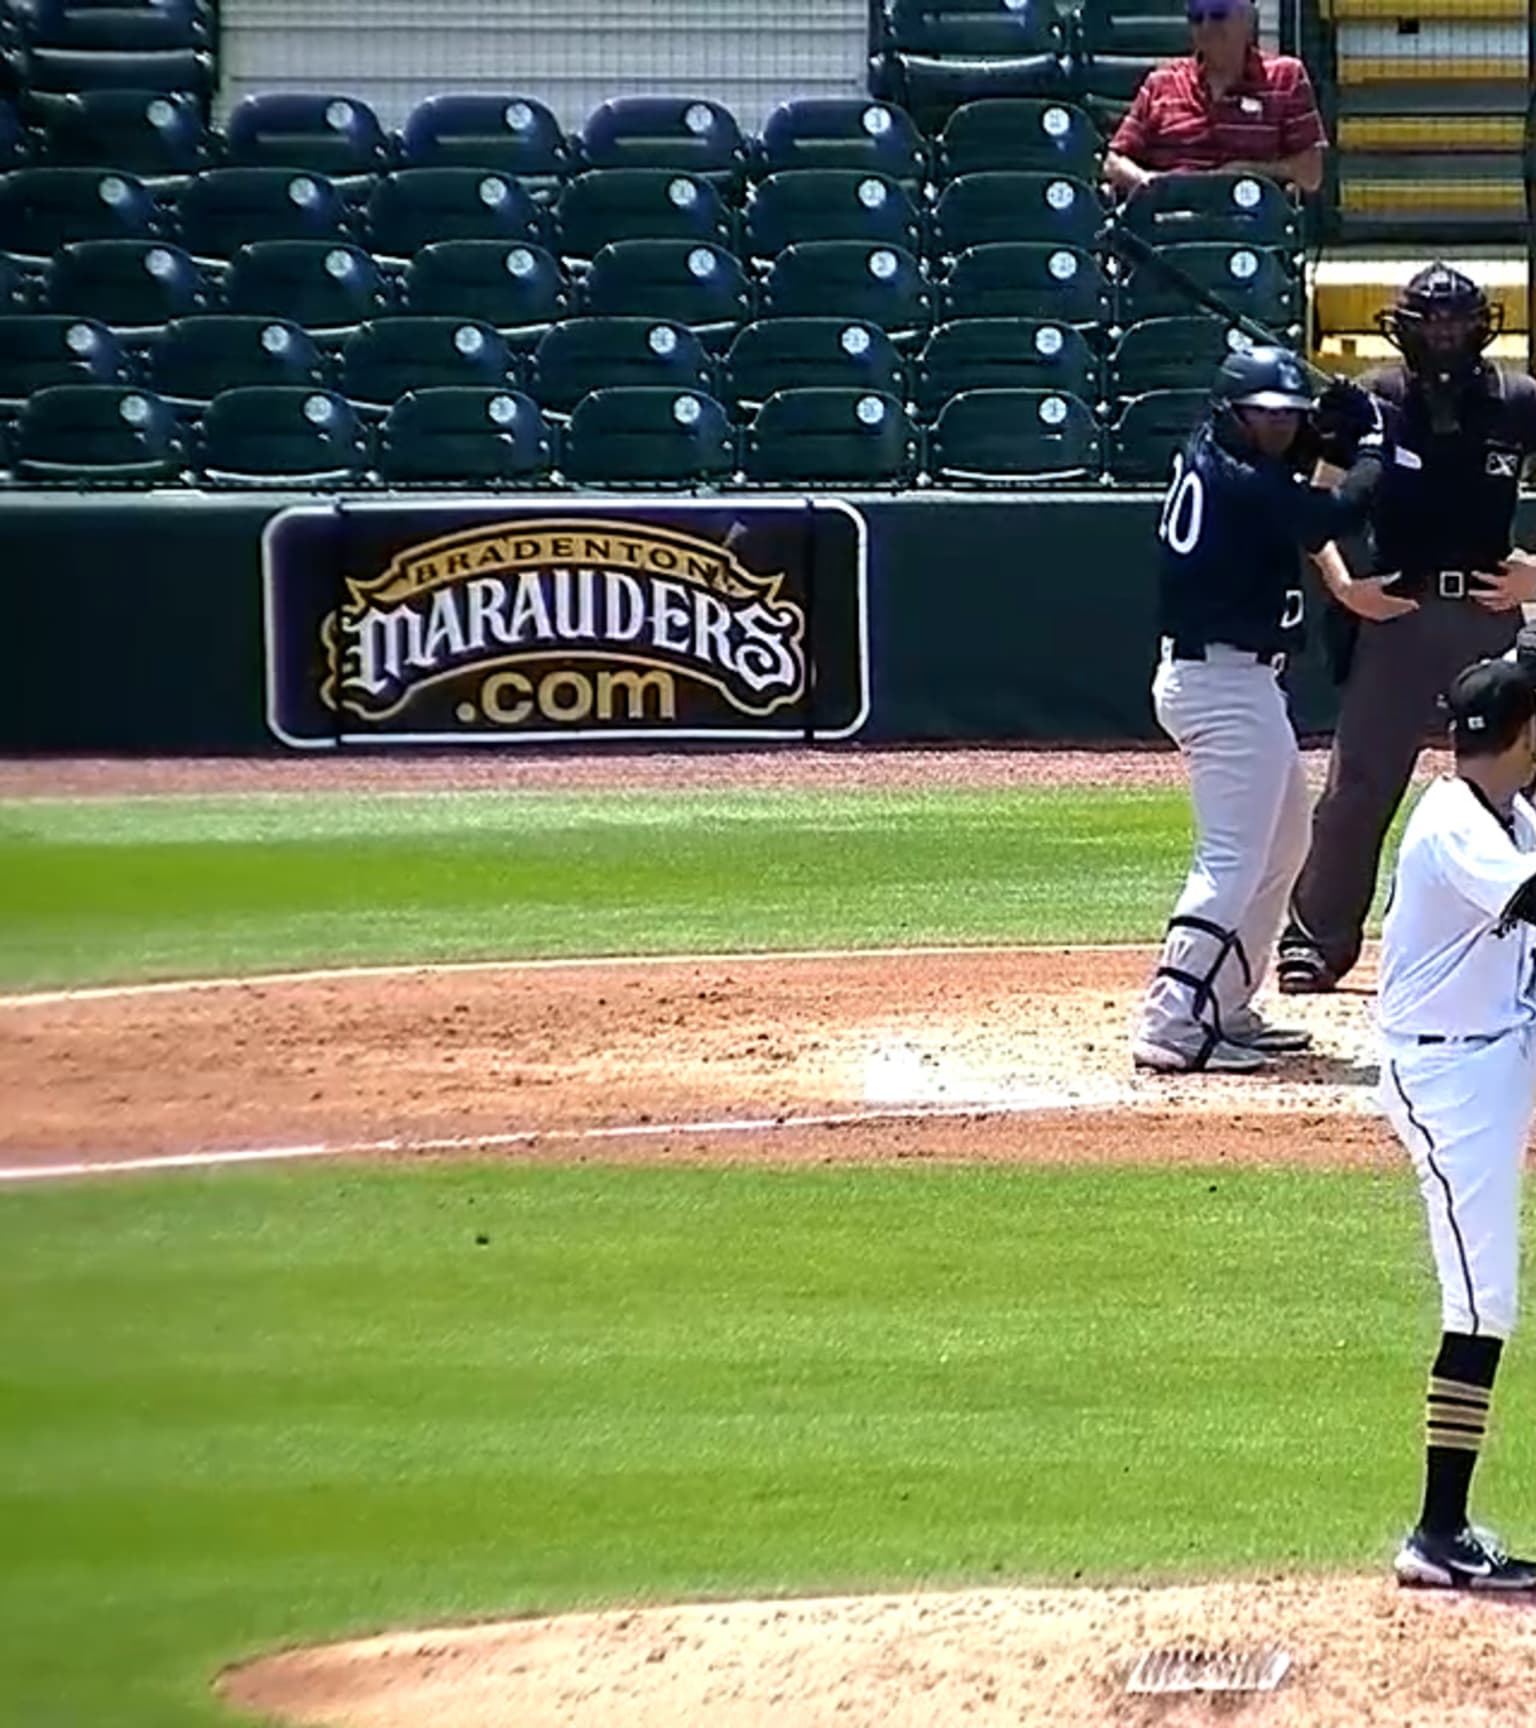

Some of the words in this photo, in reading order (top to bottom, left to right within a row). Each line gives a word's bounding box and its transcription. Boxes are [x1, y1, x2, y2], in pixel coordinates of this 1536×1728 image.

[413, 536, 724, 587] BRADENTON
[342, 567, 798, 696] MARAUDERS
[456, 669, 676, 724] .com
